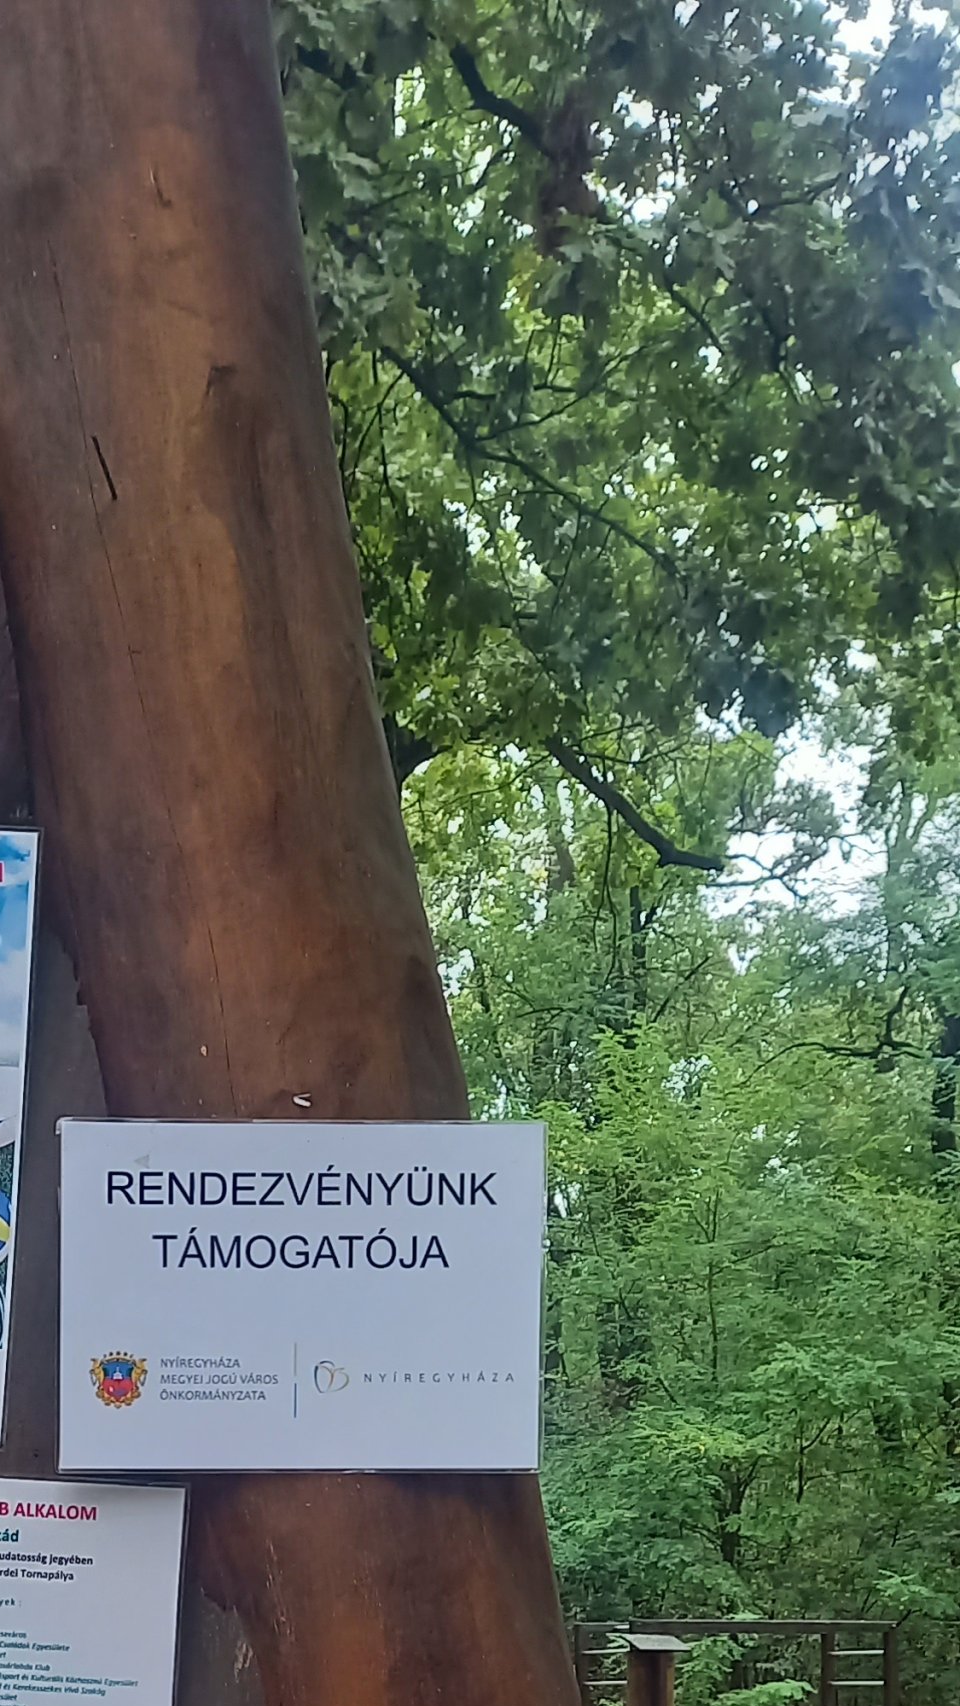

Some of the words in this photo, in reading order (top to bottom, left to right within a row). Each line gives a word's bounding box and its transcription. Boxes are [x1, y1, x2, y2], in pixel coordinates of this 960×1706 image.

[106, 1165, 497, 1206] RENDEZVÉNYÜNK
[152, 1226, 449, 1269] TÁMOGATÓJA
[160, 1356, 240, 1368] NYÍREGYHÁZA
[160, 1374, 203, 1384] MEGYEI
[205, 1372, 237, 1384] JOGÚ
[240, 1372, 278, 1384] VÁROS
[159, 1389, 266, 1400] ÖNKORMÁNYZATA
[13, 1502, 96, 1521] ALKALOM
[48, 1554, 93, 1566] jegyében
[20, 1569, 74, 1582] Tornapálya
